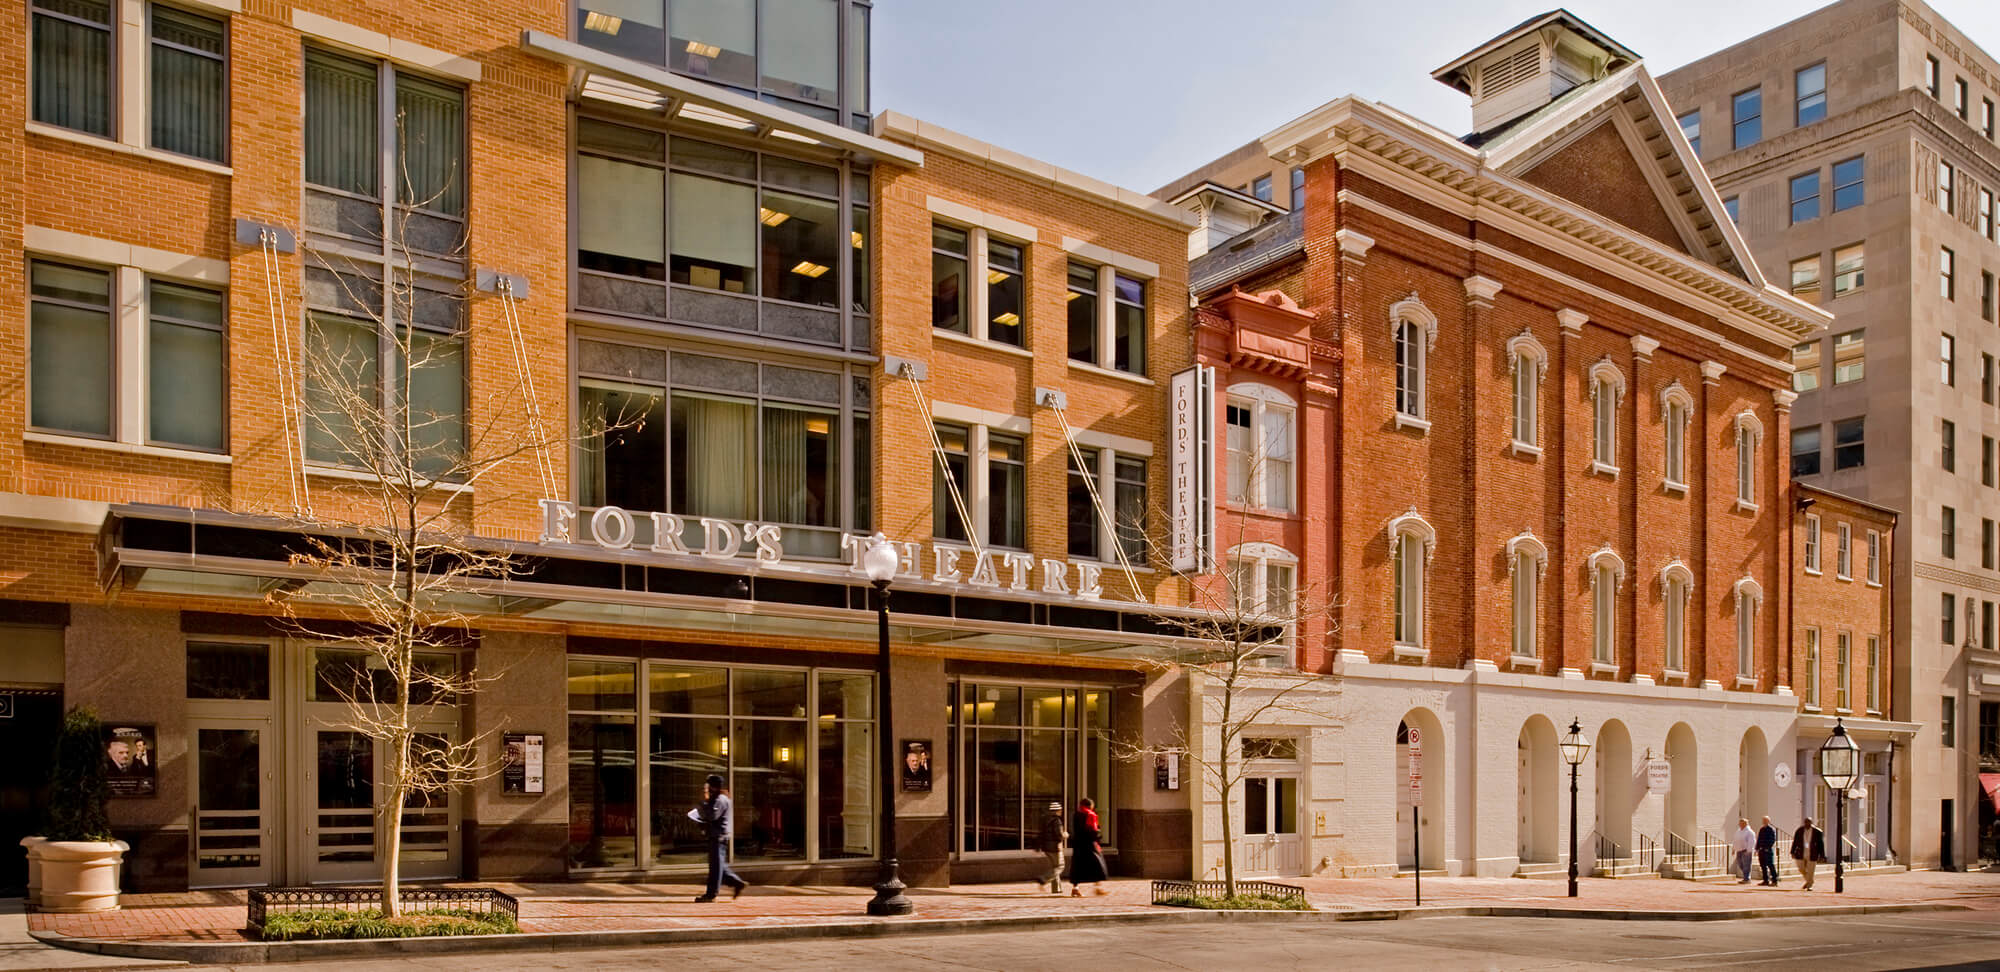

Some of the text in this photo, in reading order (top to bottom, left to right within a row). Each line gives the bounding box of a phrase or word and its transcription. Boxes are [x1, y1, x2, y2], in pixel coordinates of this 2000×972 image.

[538, 499, 784, 564] FORD'S
[1177, 385, 1189, 559] FORD'S THEATRE
